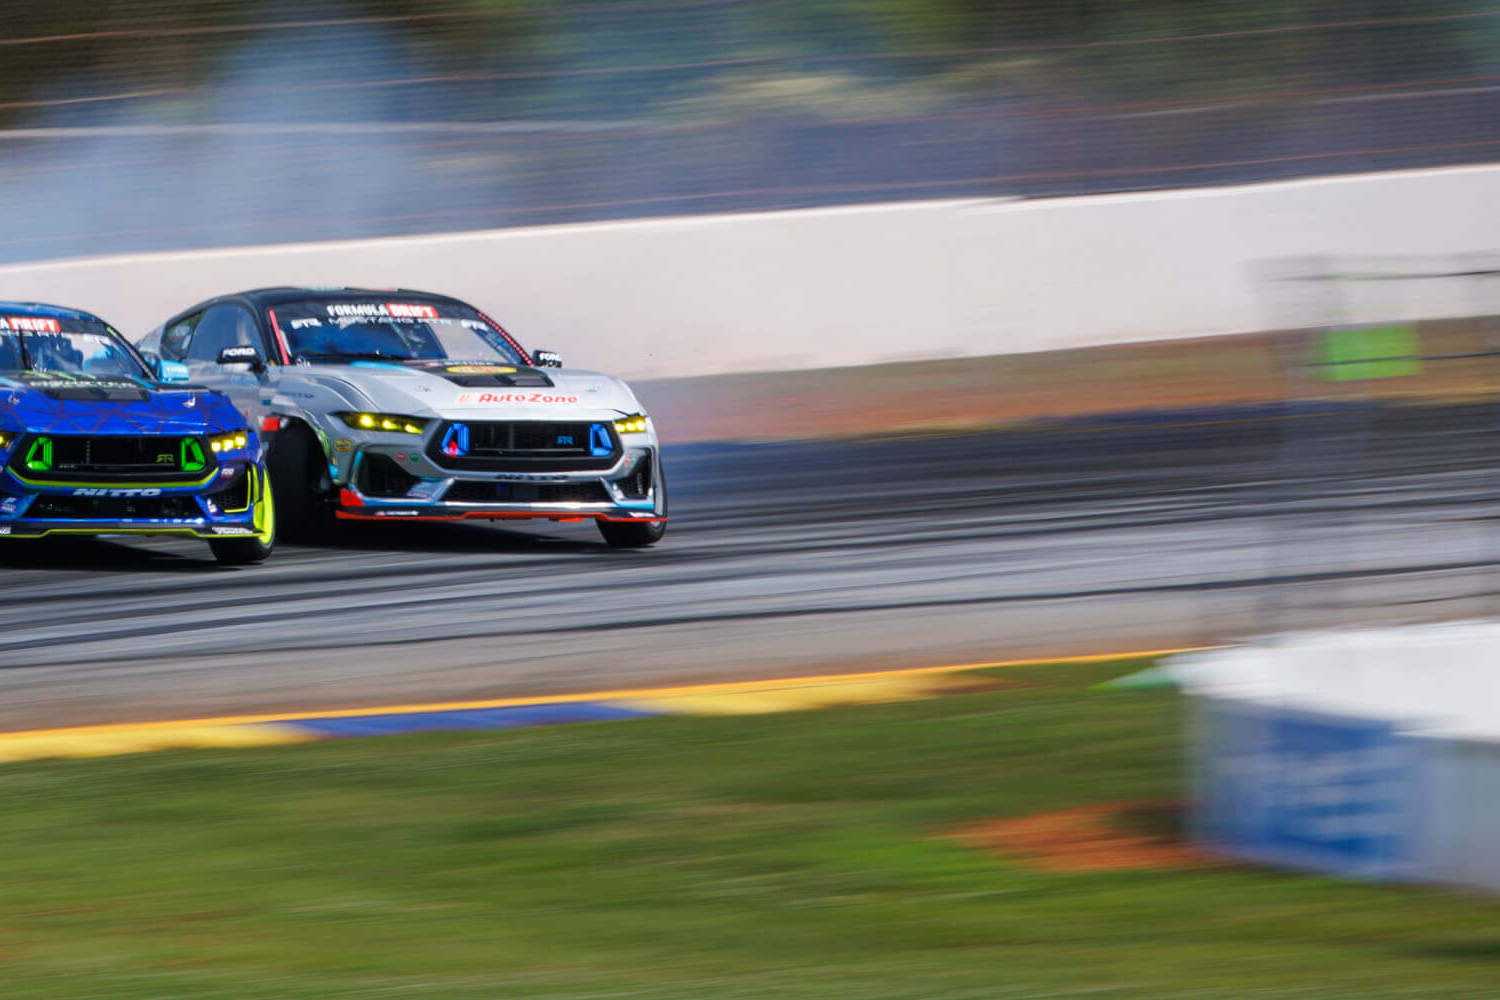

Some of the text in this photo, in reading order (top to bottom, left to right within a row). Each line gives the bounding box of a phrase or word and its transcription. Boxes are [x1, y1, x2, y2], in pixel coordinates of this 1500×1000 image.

[327, 304, 434, 317] FORMULA DRIFT
[11, 319, 57, 331] DRIFT
[222, 347, 257, 357] FORD
[479, 393, 579, 404] AutoZone
[73, 488, 161, 497] NITTO
